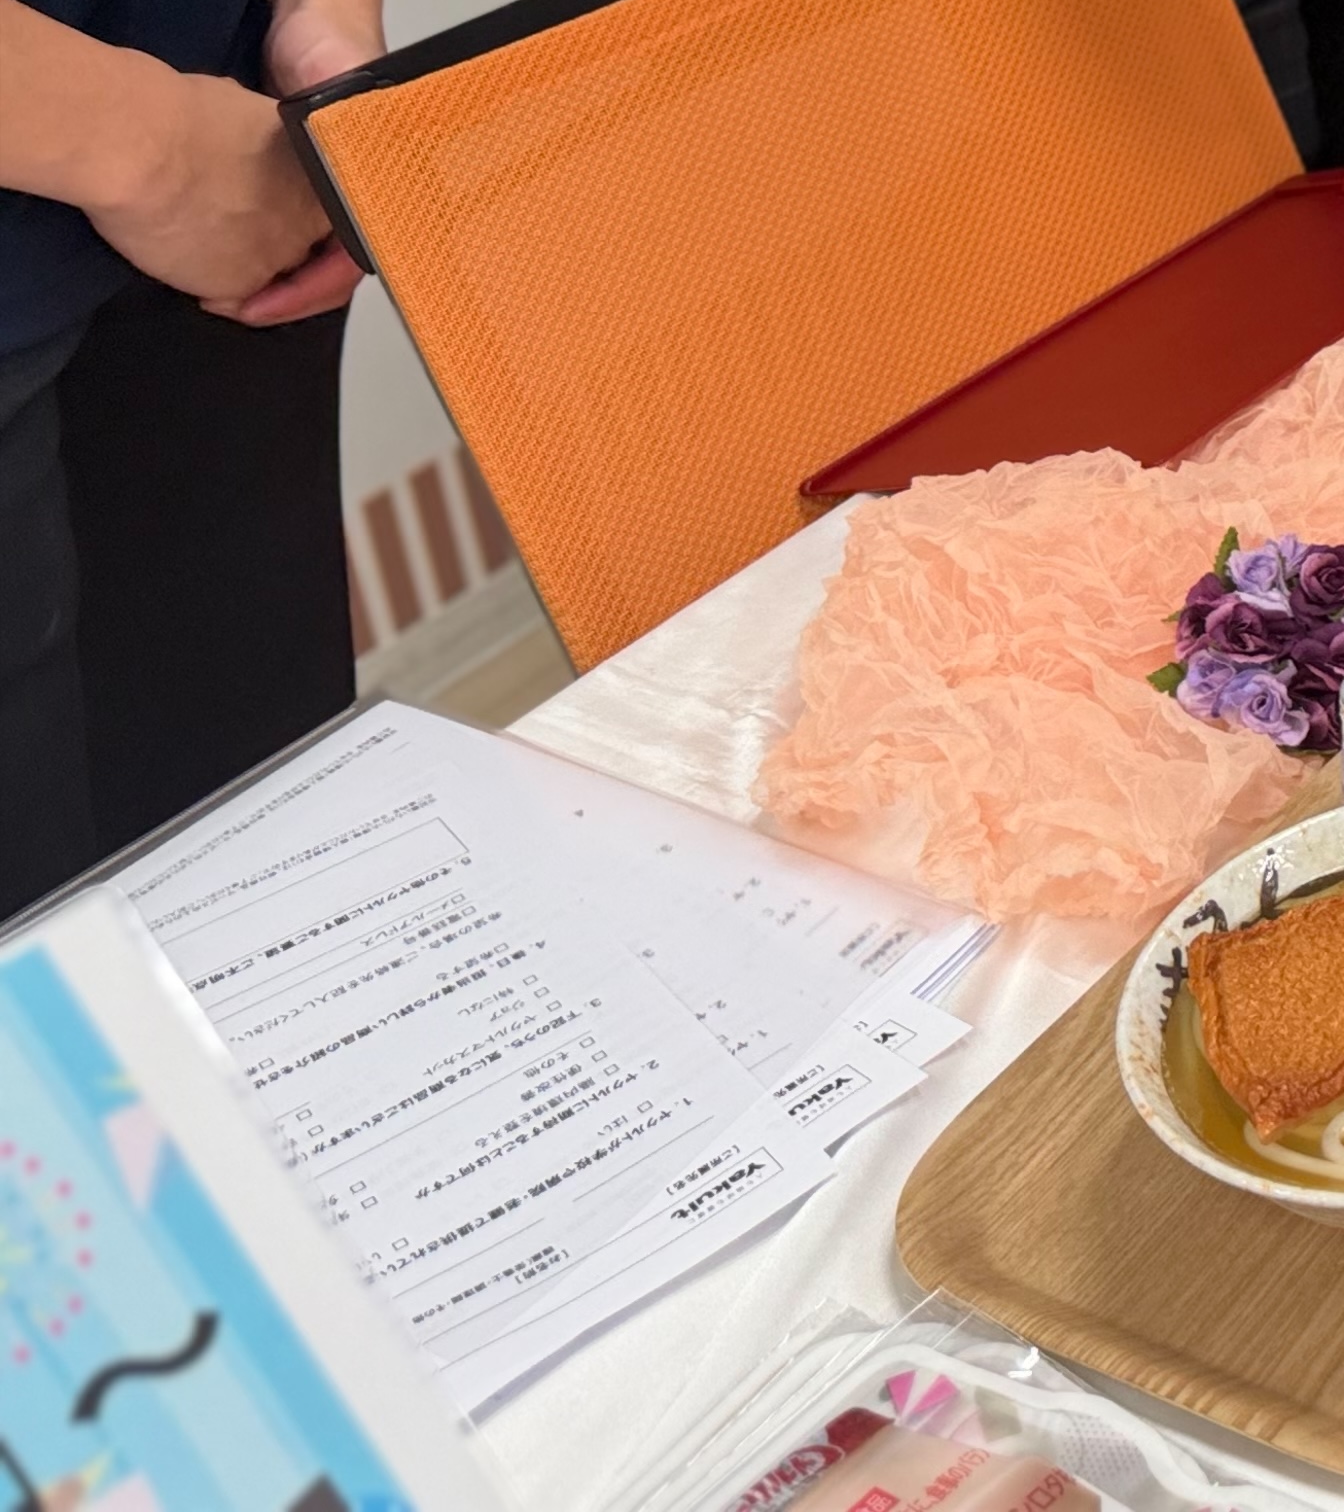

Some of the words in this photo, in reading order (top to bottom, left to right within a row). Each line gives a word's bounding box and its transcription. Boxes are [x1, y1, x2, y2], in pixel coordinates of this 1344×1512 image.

[185, 865, 454, 994] その他ヤクルトに関するご要望、ご不明点
[358, 898, 452, 949] メールアドレス
[225, 906, 503, 1049] 希望の場合、ご連絡先を記入してください。
[454, 983, 513, 1021] 特になし
[486, 996, 526, 1023] ジョア
[419, 1010, 538, 1079] ヤクルトマスカット
[520, 1047, 572, 1081] その他
[784, 1071, 854, 1117] Yaku
[412, 1066, 639, 1205] ヤクルトに期待することは何ですか
[594, 1112, 629, 1138] はい
[362, 1103, 674, 1292] ヤクルトが学校や病院・老健で提供されてい
[666, 1157, 767, 1224] Yakult
